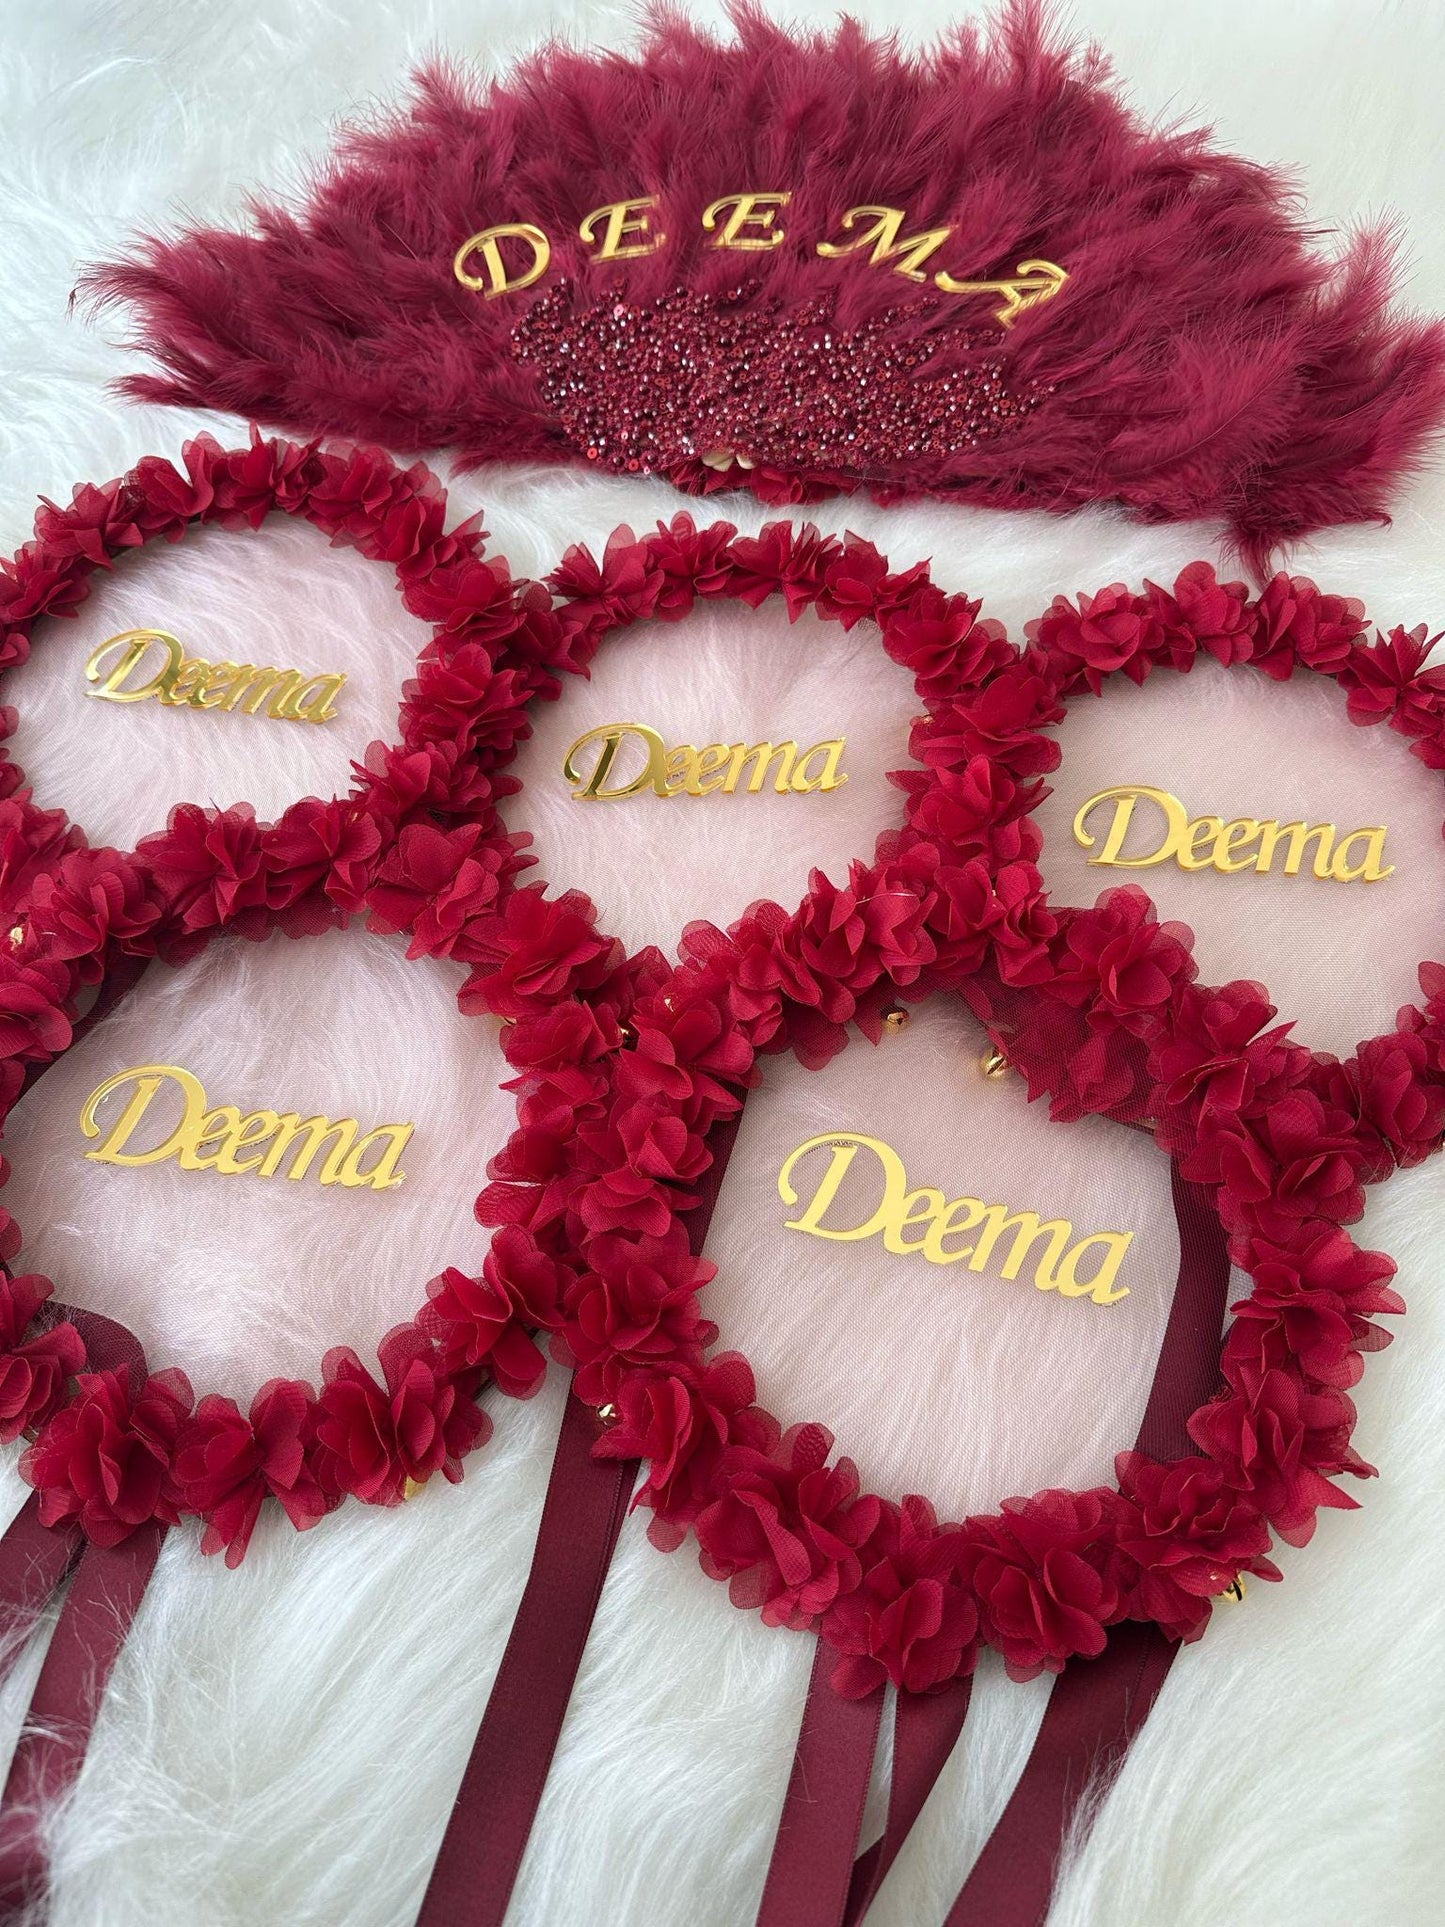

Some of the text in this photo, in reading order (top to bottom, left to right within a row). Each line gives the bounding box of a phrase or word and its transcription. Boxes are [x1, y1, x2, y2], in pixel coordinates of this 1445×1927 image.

[453, 191, 1070, 329] DEEMA
[85, 628, 348, 724] Deema
[563, 722, 850, 803] Deema
[1073, 785, 1397, 884] Deema
[80, 1064, 416, 1192] Deema
[777, 1131, 1135, 1307] Deema
